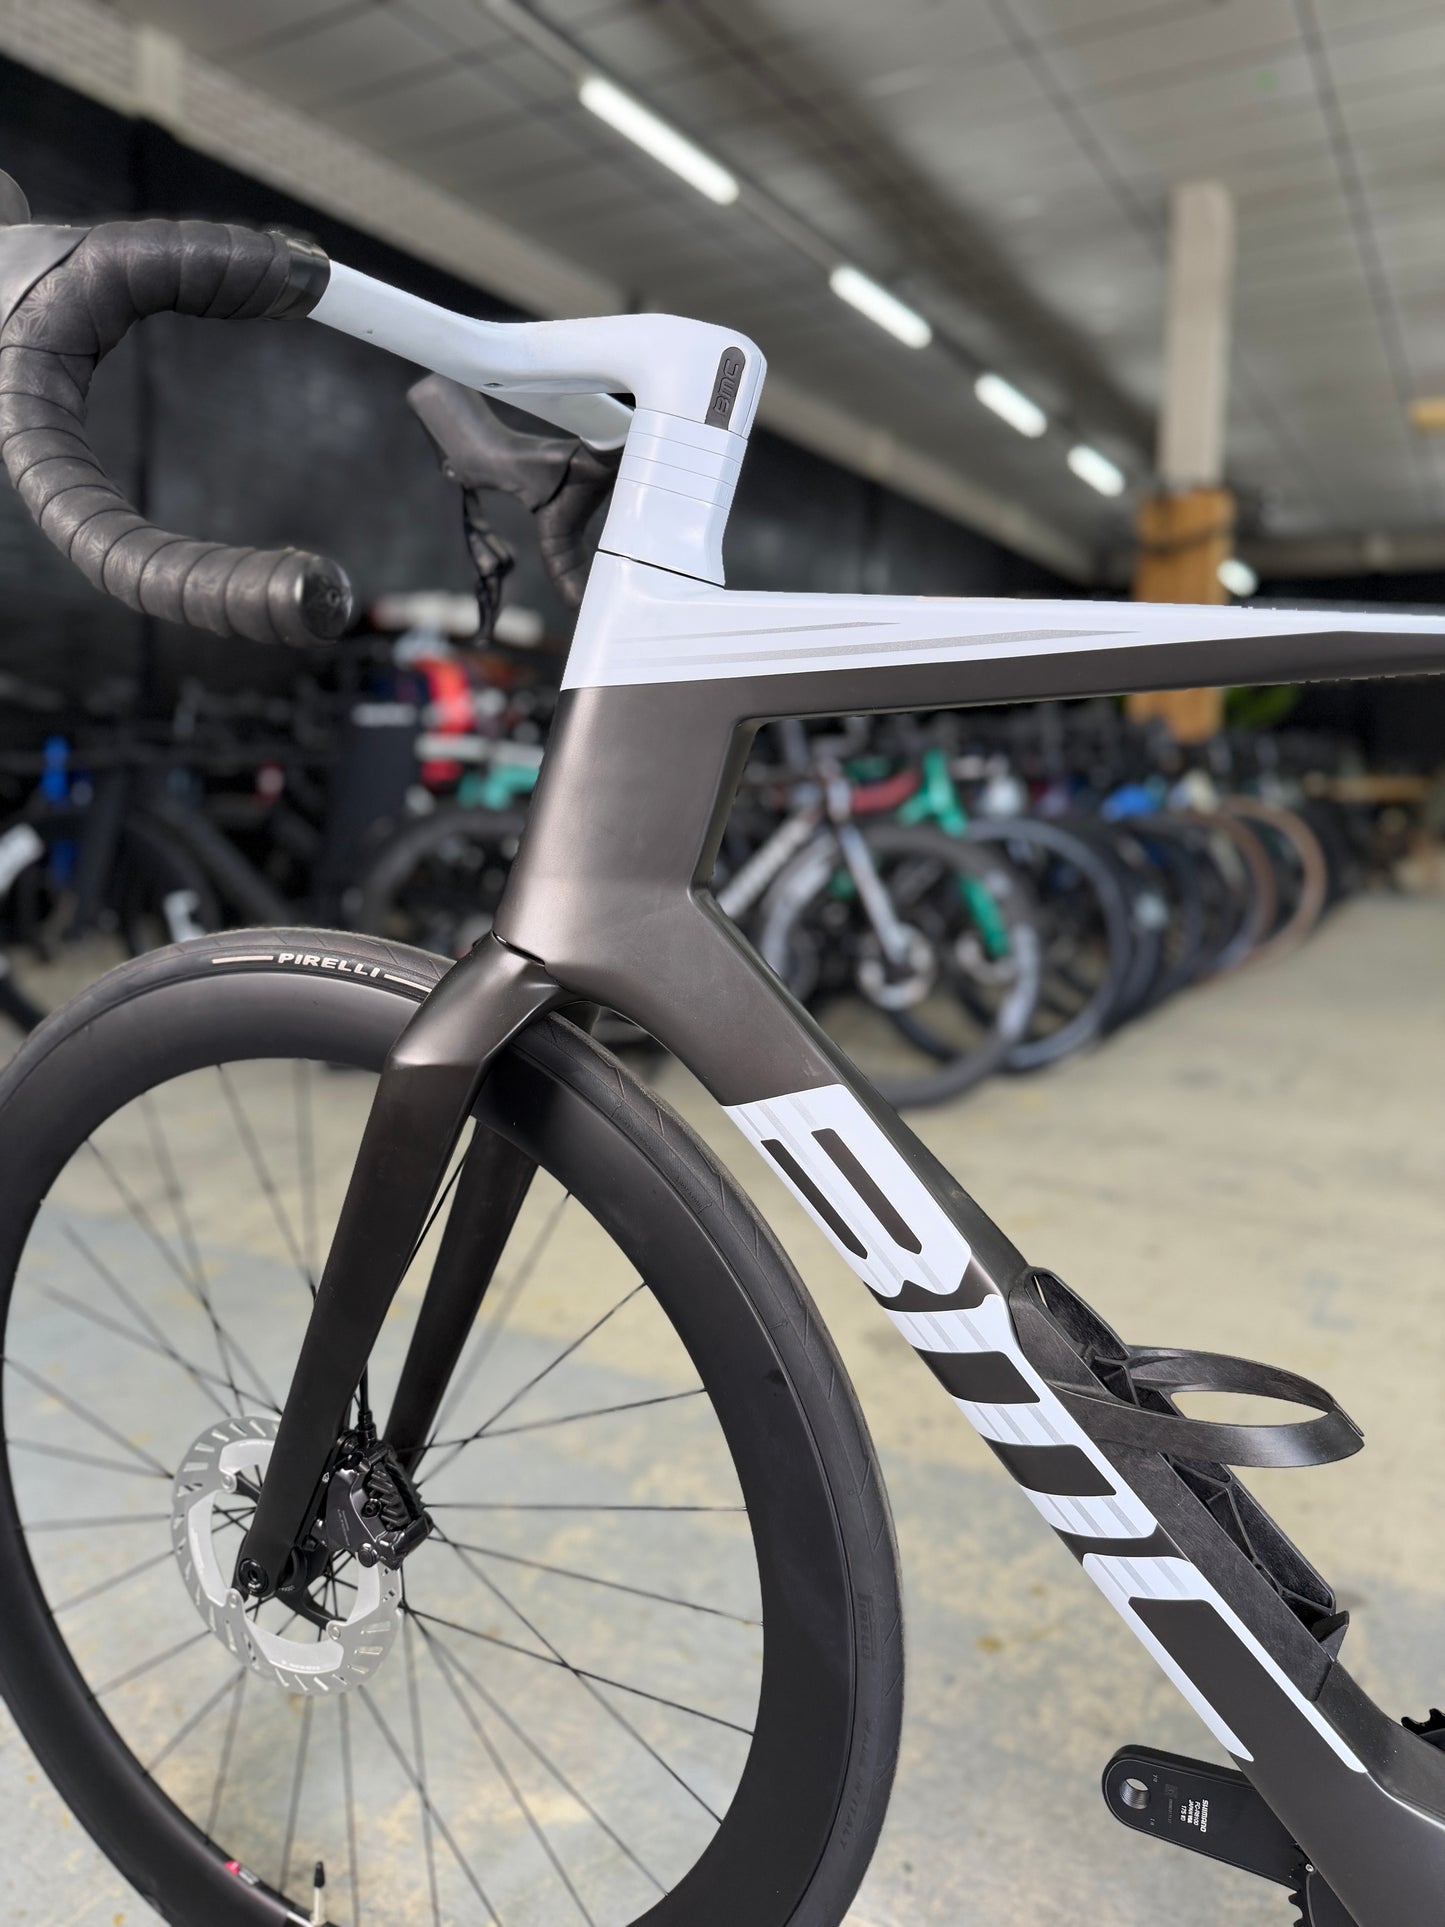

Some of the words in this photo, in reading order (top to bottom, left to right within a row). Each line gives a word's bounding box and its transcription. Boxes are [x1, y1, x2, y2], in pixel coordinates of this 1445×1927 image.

[713, 359, 739, 415] BMC
[278, 952, 381, 978] PIRELLI
[1200, 1799, 1209, 1833] SHIMANO
